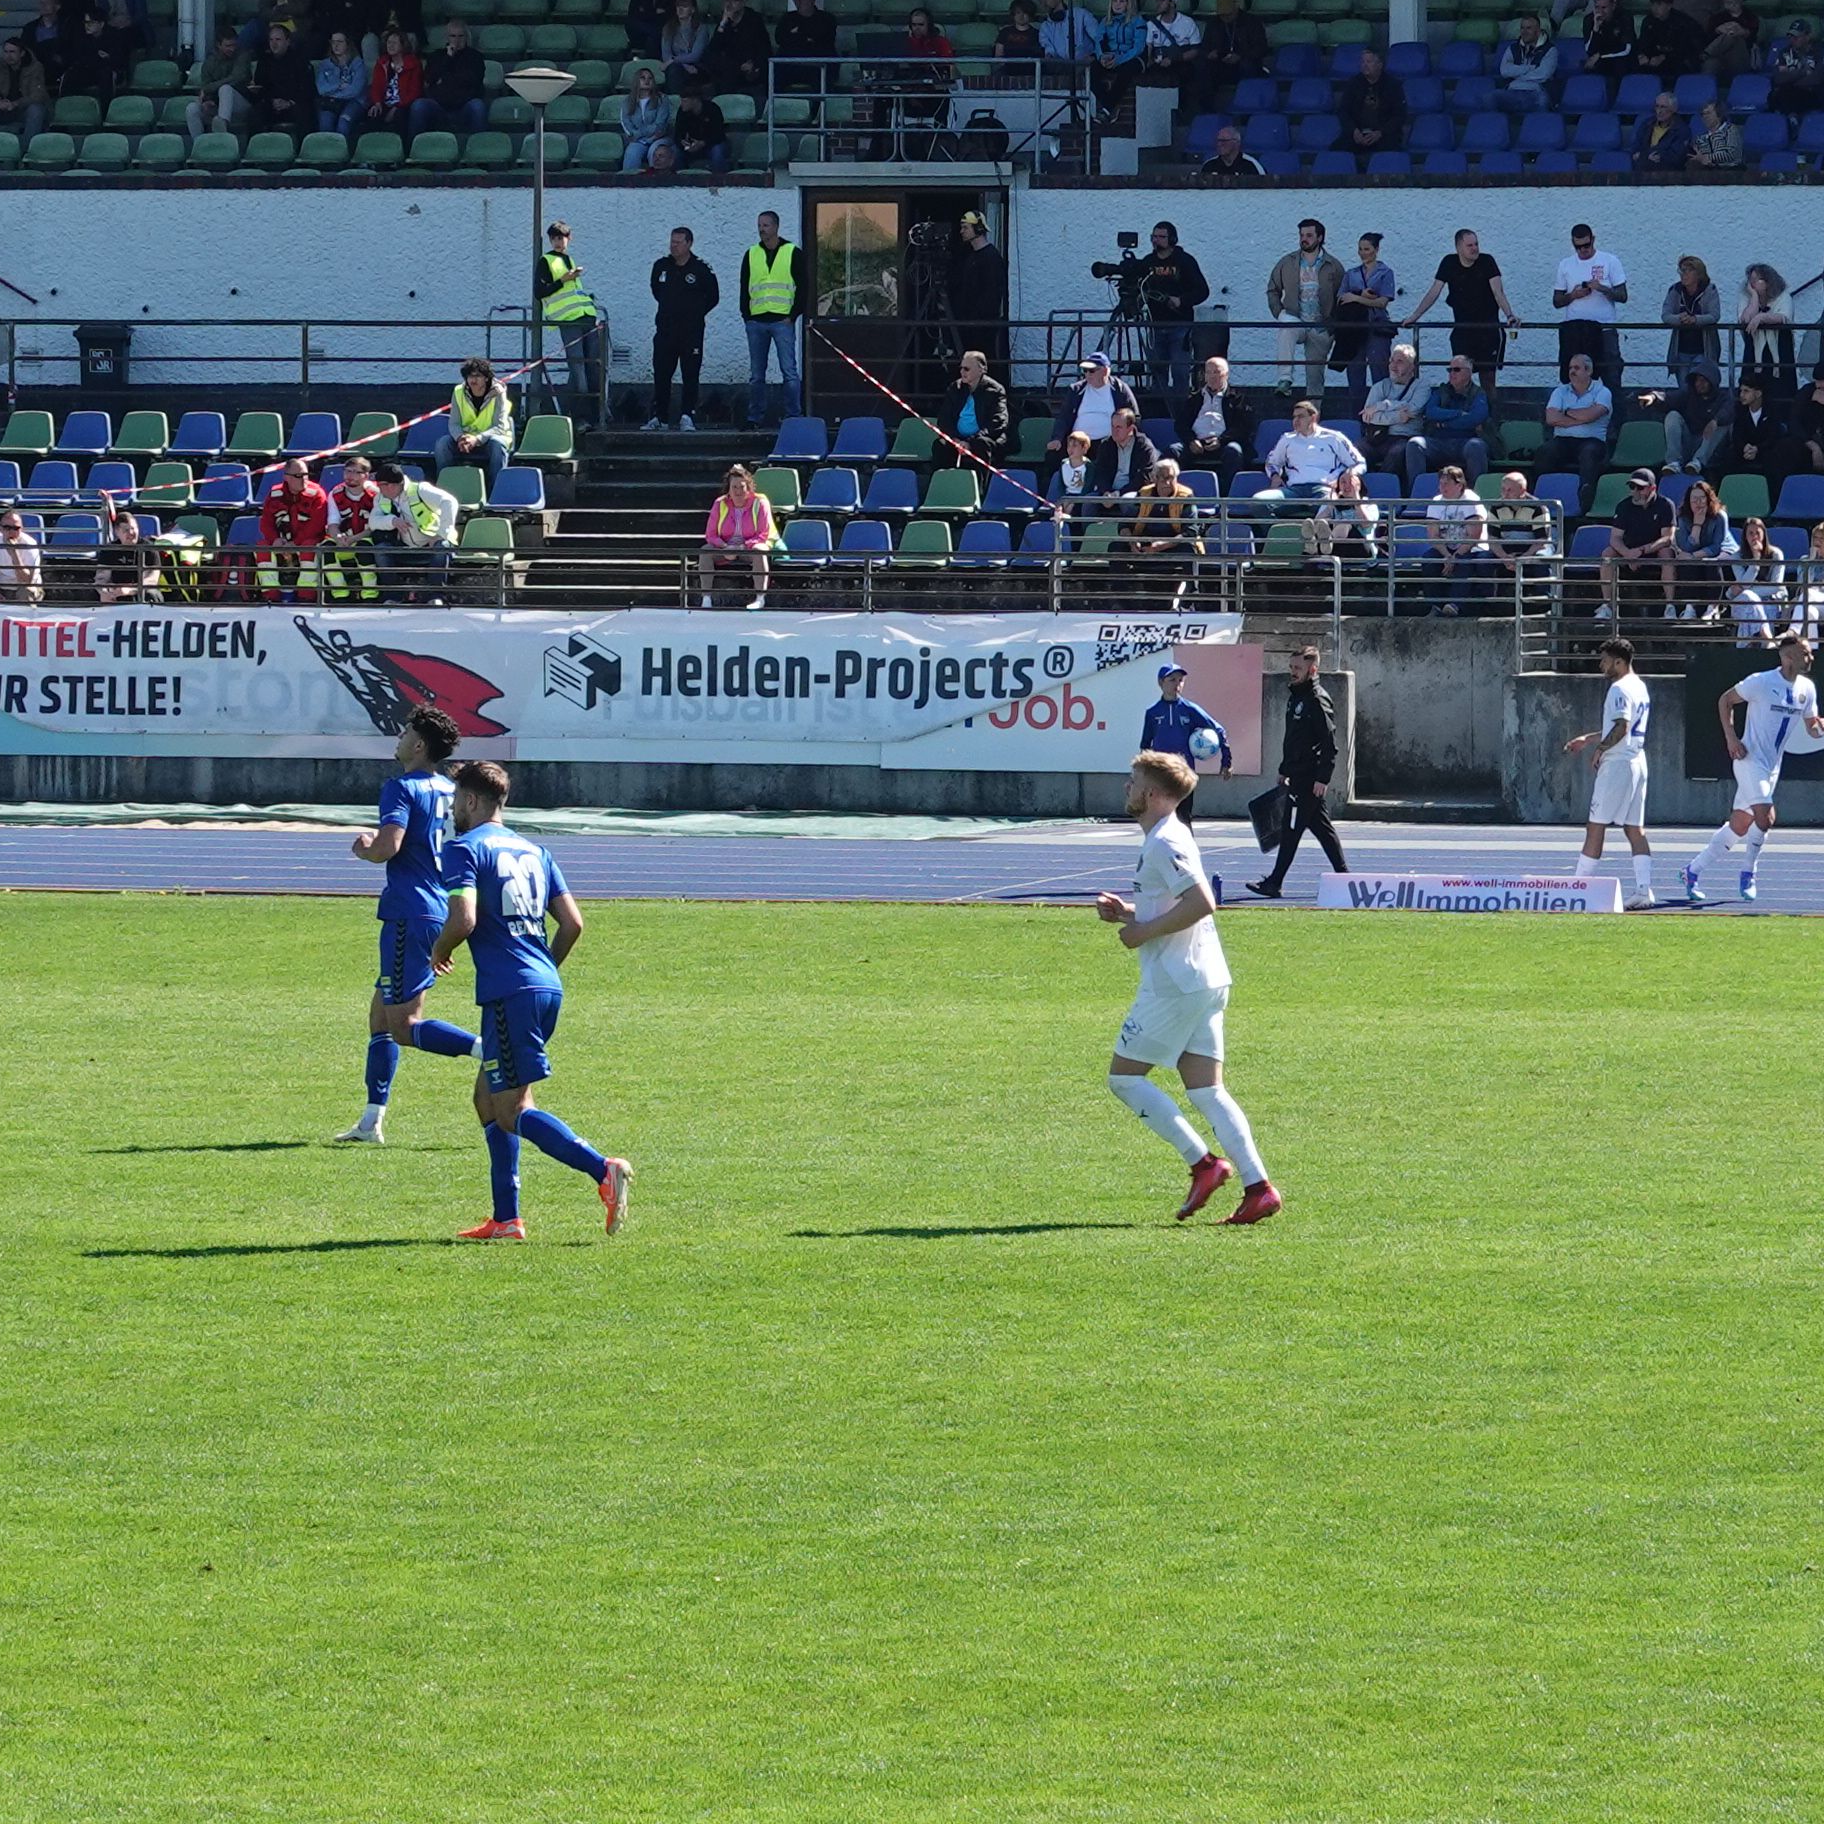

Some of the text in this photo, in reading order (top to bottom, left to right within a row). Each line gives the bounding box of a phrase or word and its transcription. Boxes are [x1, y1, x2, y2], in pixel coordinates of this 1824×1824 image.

[39, 675, 182, 717] STELLE!
[988, 683, 1106, 731] Job.
[1442, 878, 1588, 890] www.well-immobilien.de
